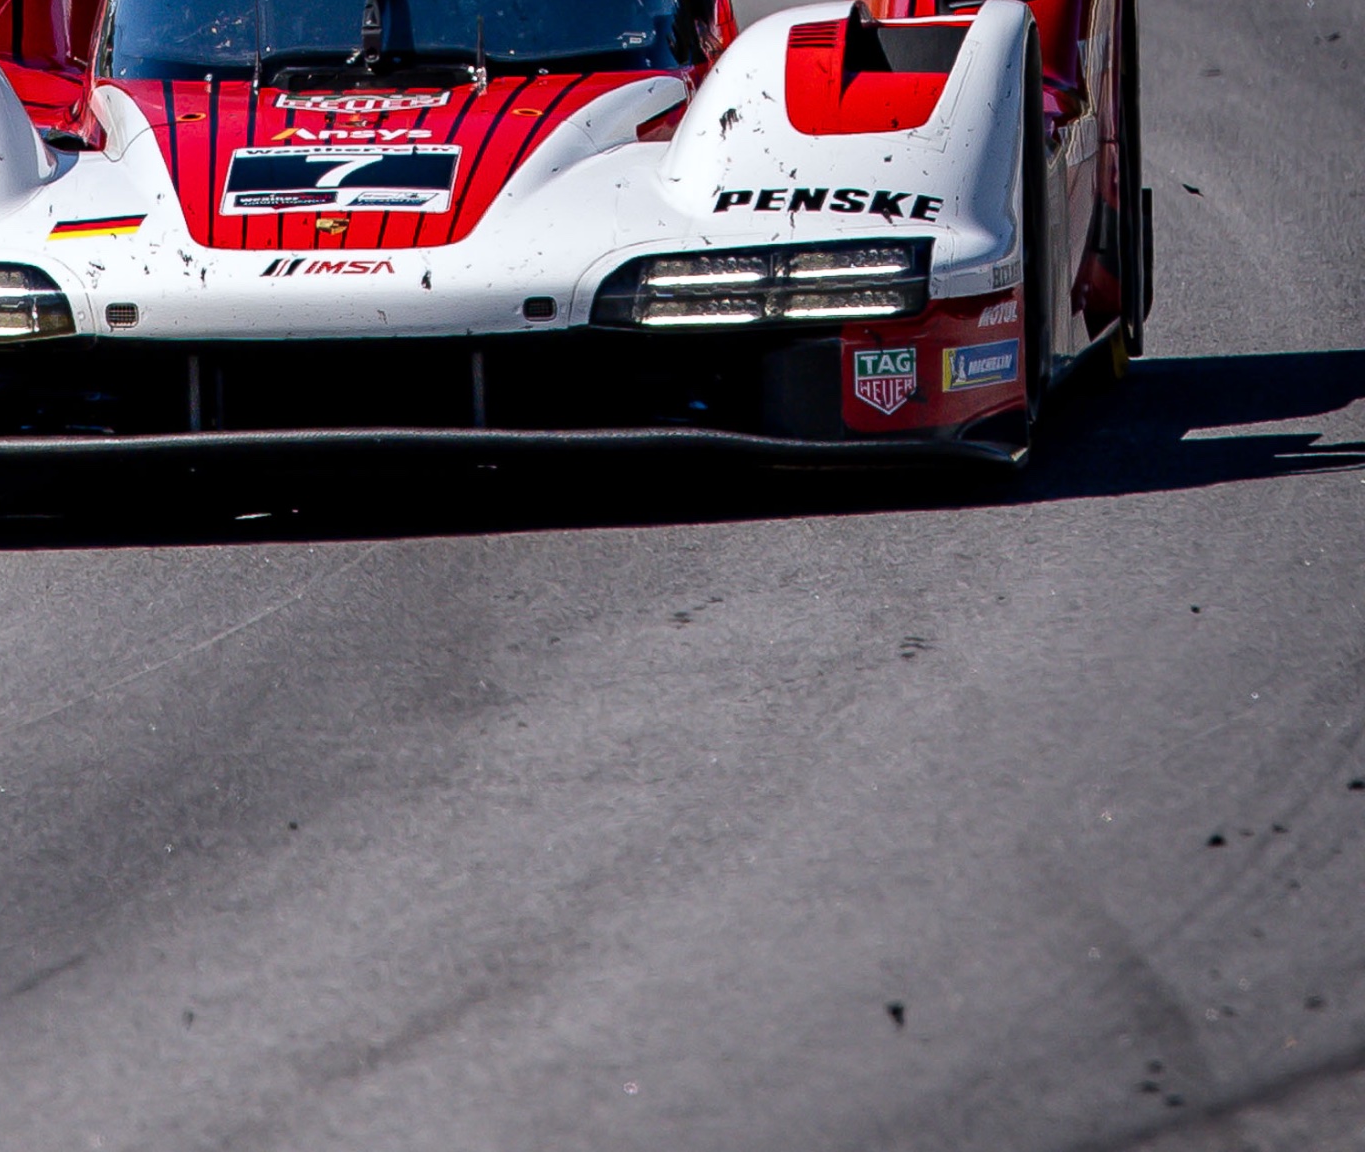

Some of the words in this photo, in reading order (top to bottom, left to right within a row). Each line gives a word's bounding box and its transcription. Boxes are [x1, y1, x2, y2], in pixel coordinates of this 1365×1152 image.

[271, 128, 432, 140] Ansys
[305, 154, 383, 187] 7
[713, 188, 944, 222] PENSKE
[304, 261, 395, 274] IMSA
[861, 354, 910, 374] TAG
[969, 355, 1012, 375] MICHELIN
[861, 380, 912, 409] HEUER
